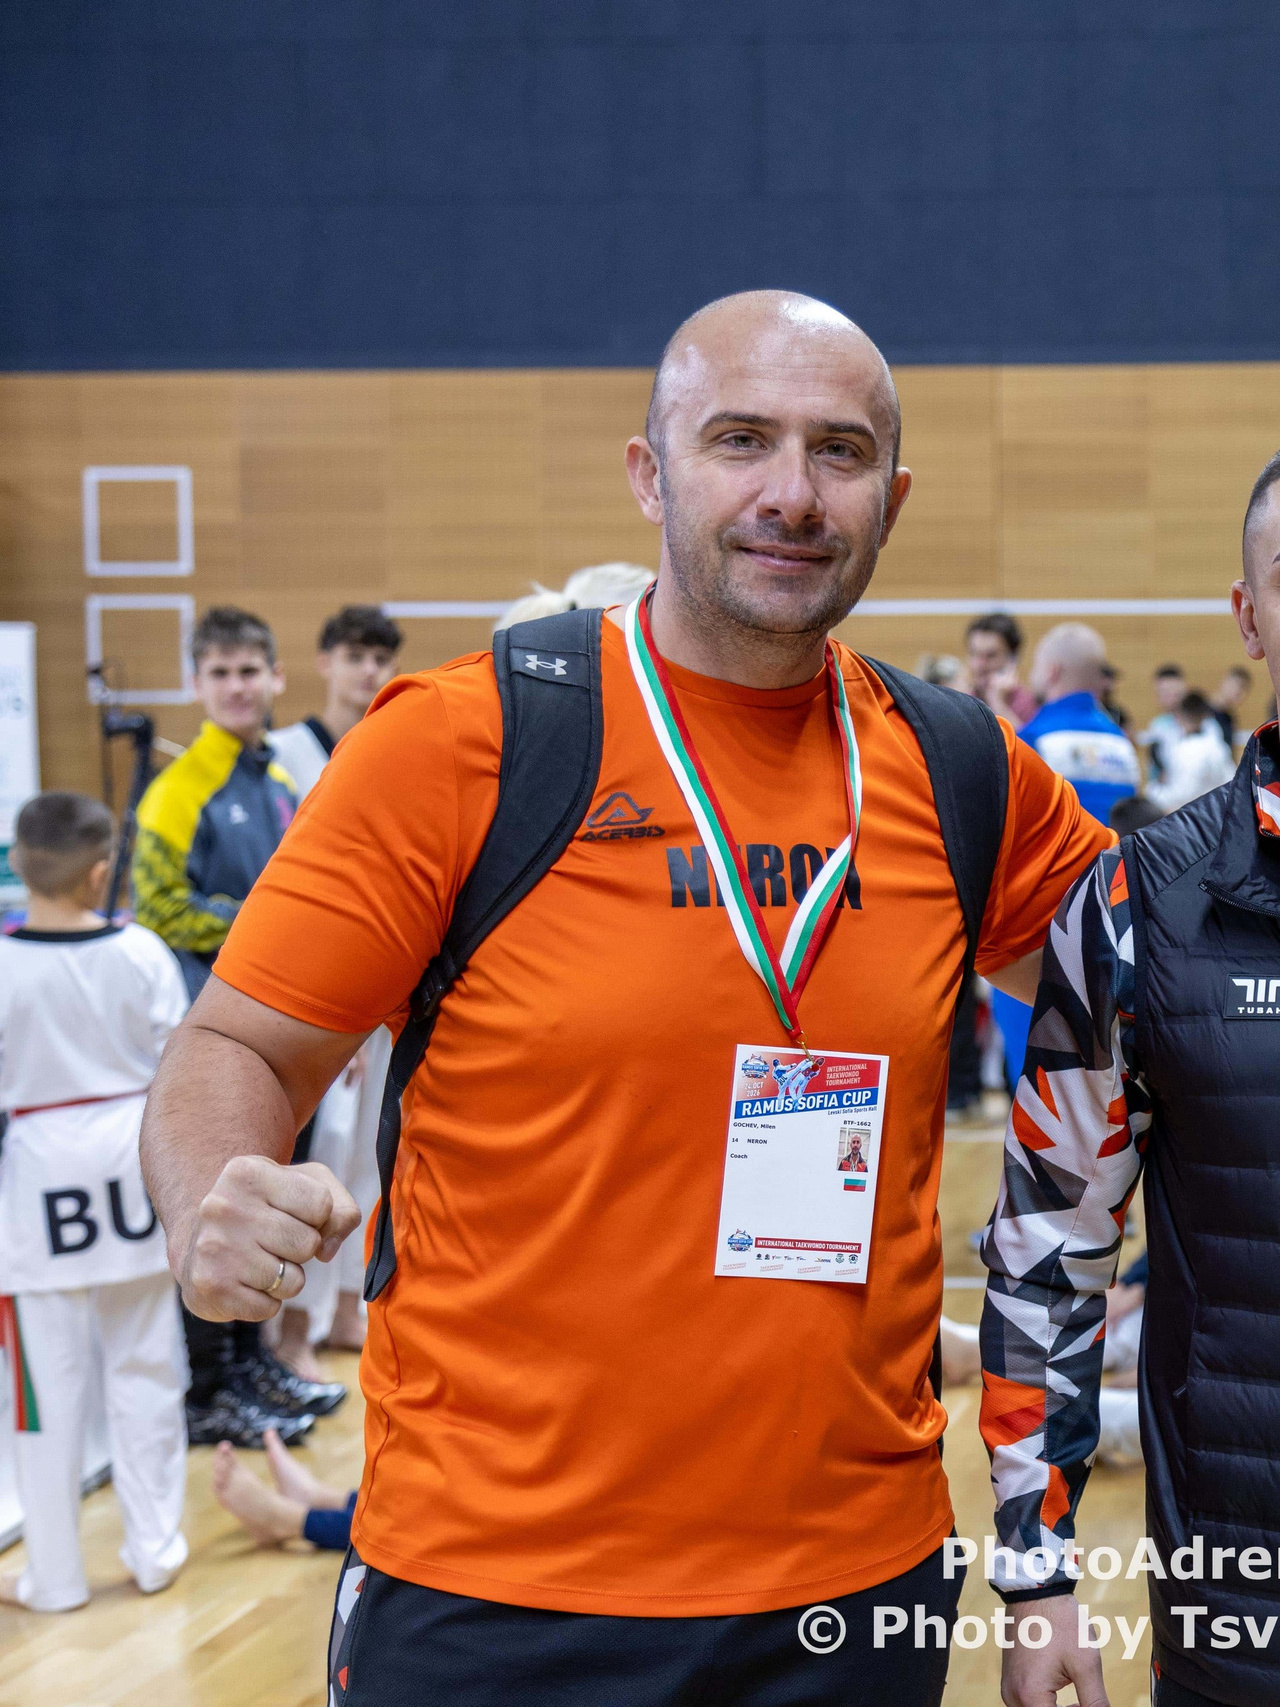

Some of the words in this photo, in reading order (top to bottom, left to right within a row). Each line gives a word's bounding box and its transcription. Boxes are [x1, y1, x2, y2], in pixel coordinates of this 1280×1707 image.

[580, 826, 665, 842] ACERBIS
[666, 843, 863, 910] NRO
[826, 1063, 867, 1073] INTERNATIONAL
[826, 1071, 860, 1079] TAEKWONDO
[825, 1077, 861, 1086] TOURNAMENT
[742, 1098, 793, 1116] RAMUS
[798, 1093, 839, 1111] SOFIA
[842, 1090, 872, 1106] CUP
[757, 1239, 794, 1248] INTERNATIONAL
[795, 1241, 826, 1250] TAEKWONDO
[826, 1243, 860, 1251] TOURNAMENT
